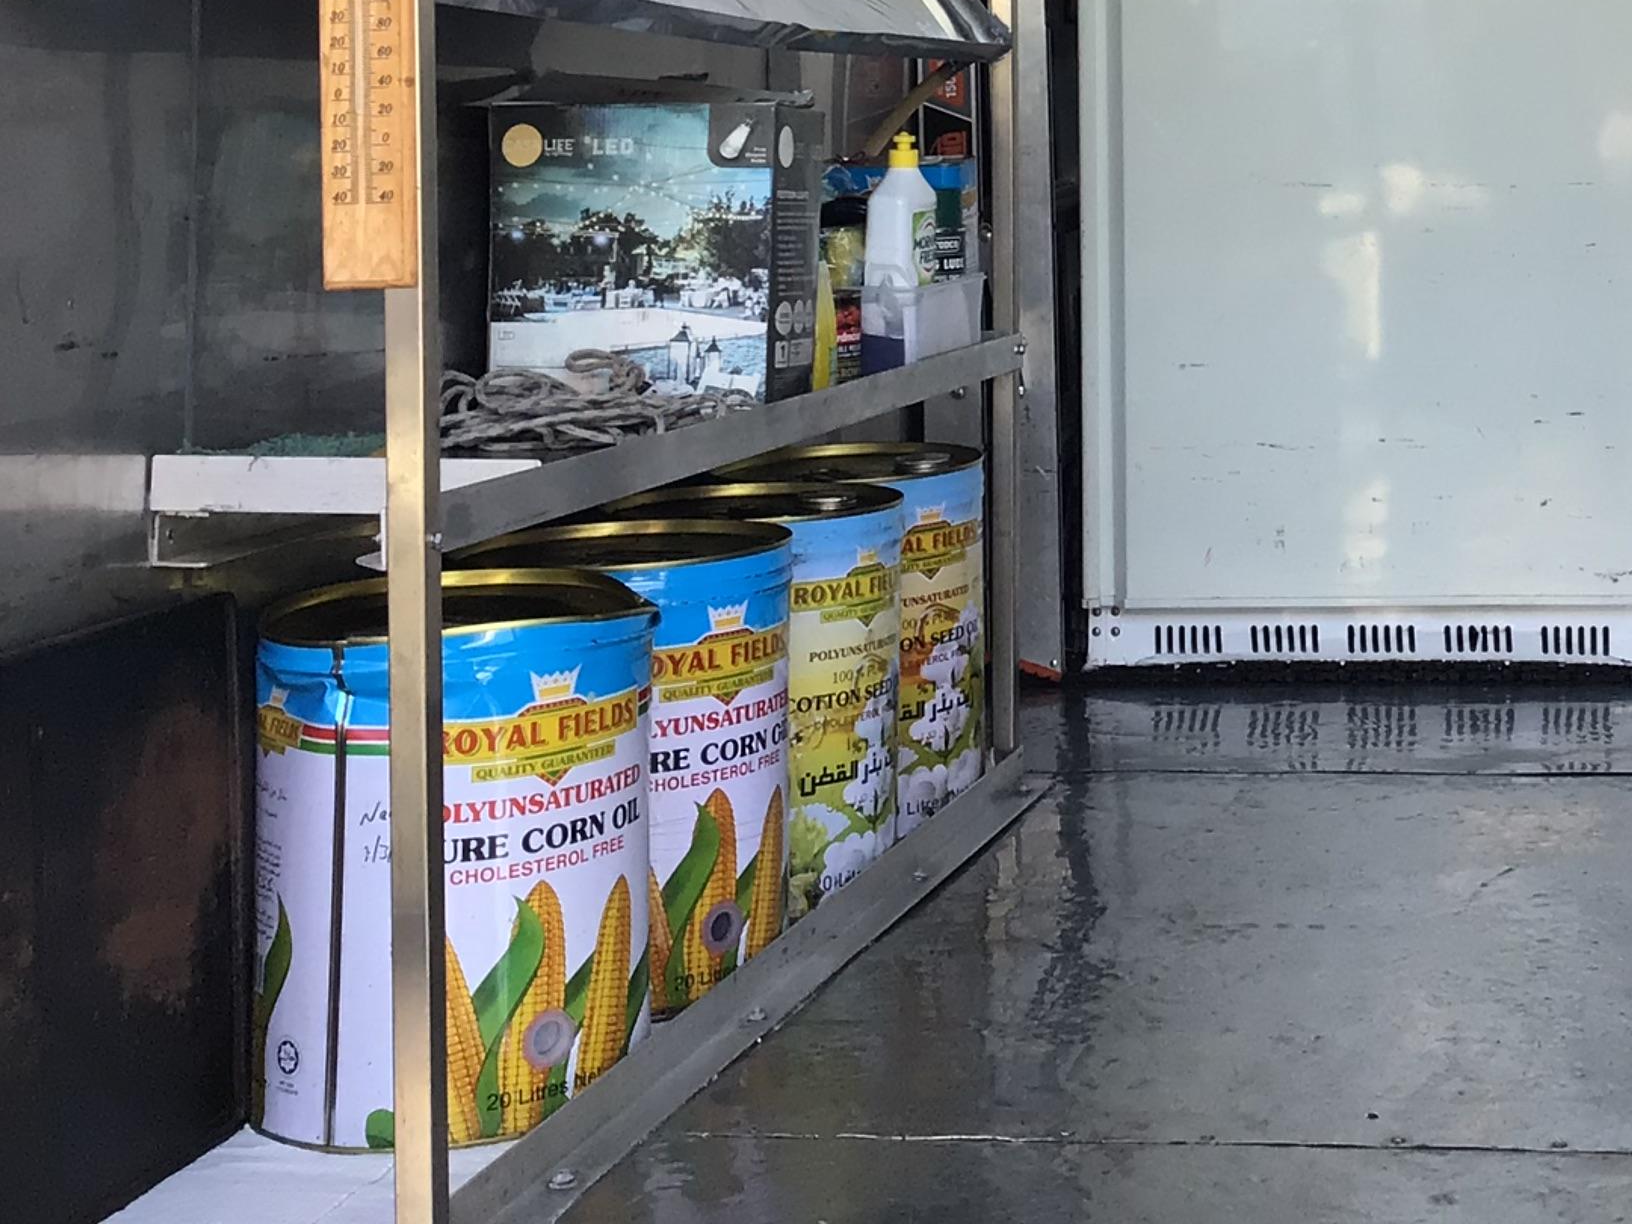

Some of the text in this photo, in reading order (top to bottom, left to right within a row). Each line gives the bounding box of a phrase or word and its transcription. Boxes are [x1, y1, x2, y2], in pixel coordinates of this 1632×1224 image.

[592, 137, 635, 155] LED
[793, 579, 866, 607] ROYAL
[662, 684, 713, 703] QUALITY
[558, 696, 635, 742] FIELDS
[475, 743, 617, 781] QUALITY GUARANTEED
[650, 747, 691, 775] RE
[700, 727, 768, 767] CORN
[757, 748, 781, 771] FREE
[443, 797, 641, 865] URE CORN OIL
[450, 834, 625, 887] CHOLESTEROL FREE
[486, 1091, 512, 1113] 20
[518, 1079, 569, 1104] Litres
